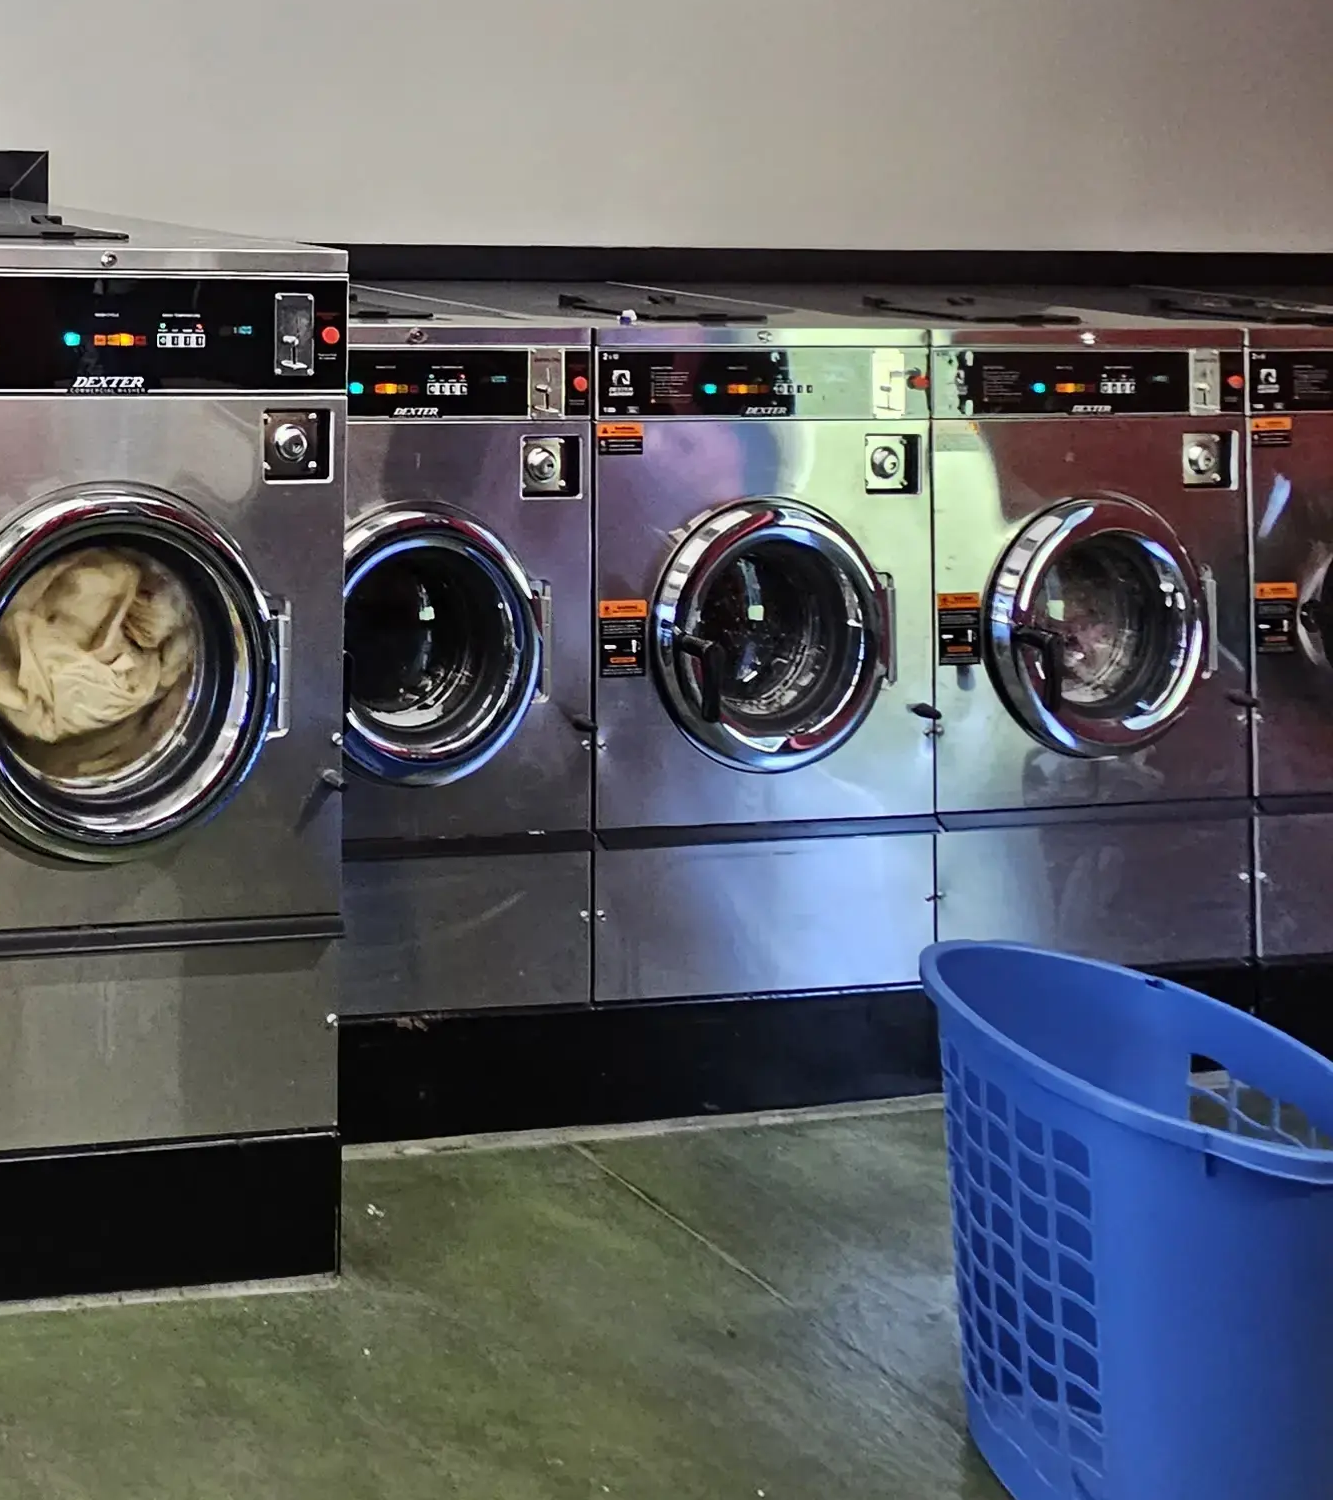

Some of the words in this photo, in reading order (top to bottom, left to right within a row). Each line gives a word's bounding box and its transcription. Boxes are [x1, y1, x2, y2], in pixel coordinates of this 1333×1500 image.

[72, 376, 145, 387] DEXTER
[393, 407, 439, 415] DEXTER
[745, 406, 788, 414] DEXTER
